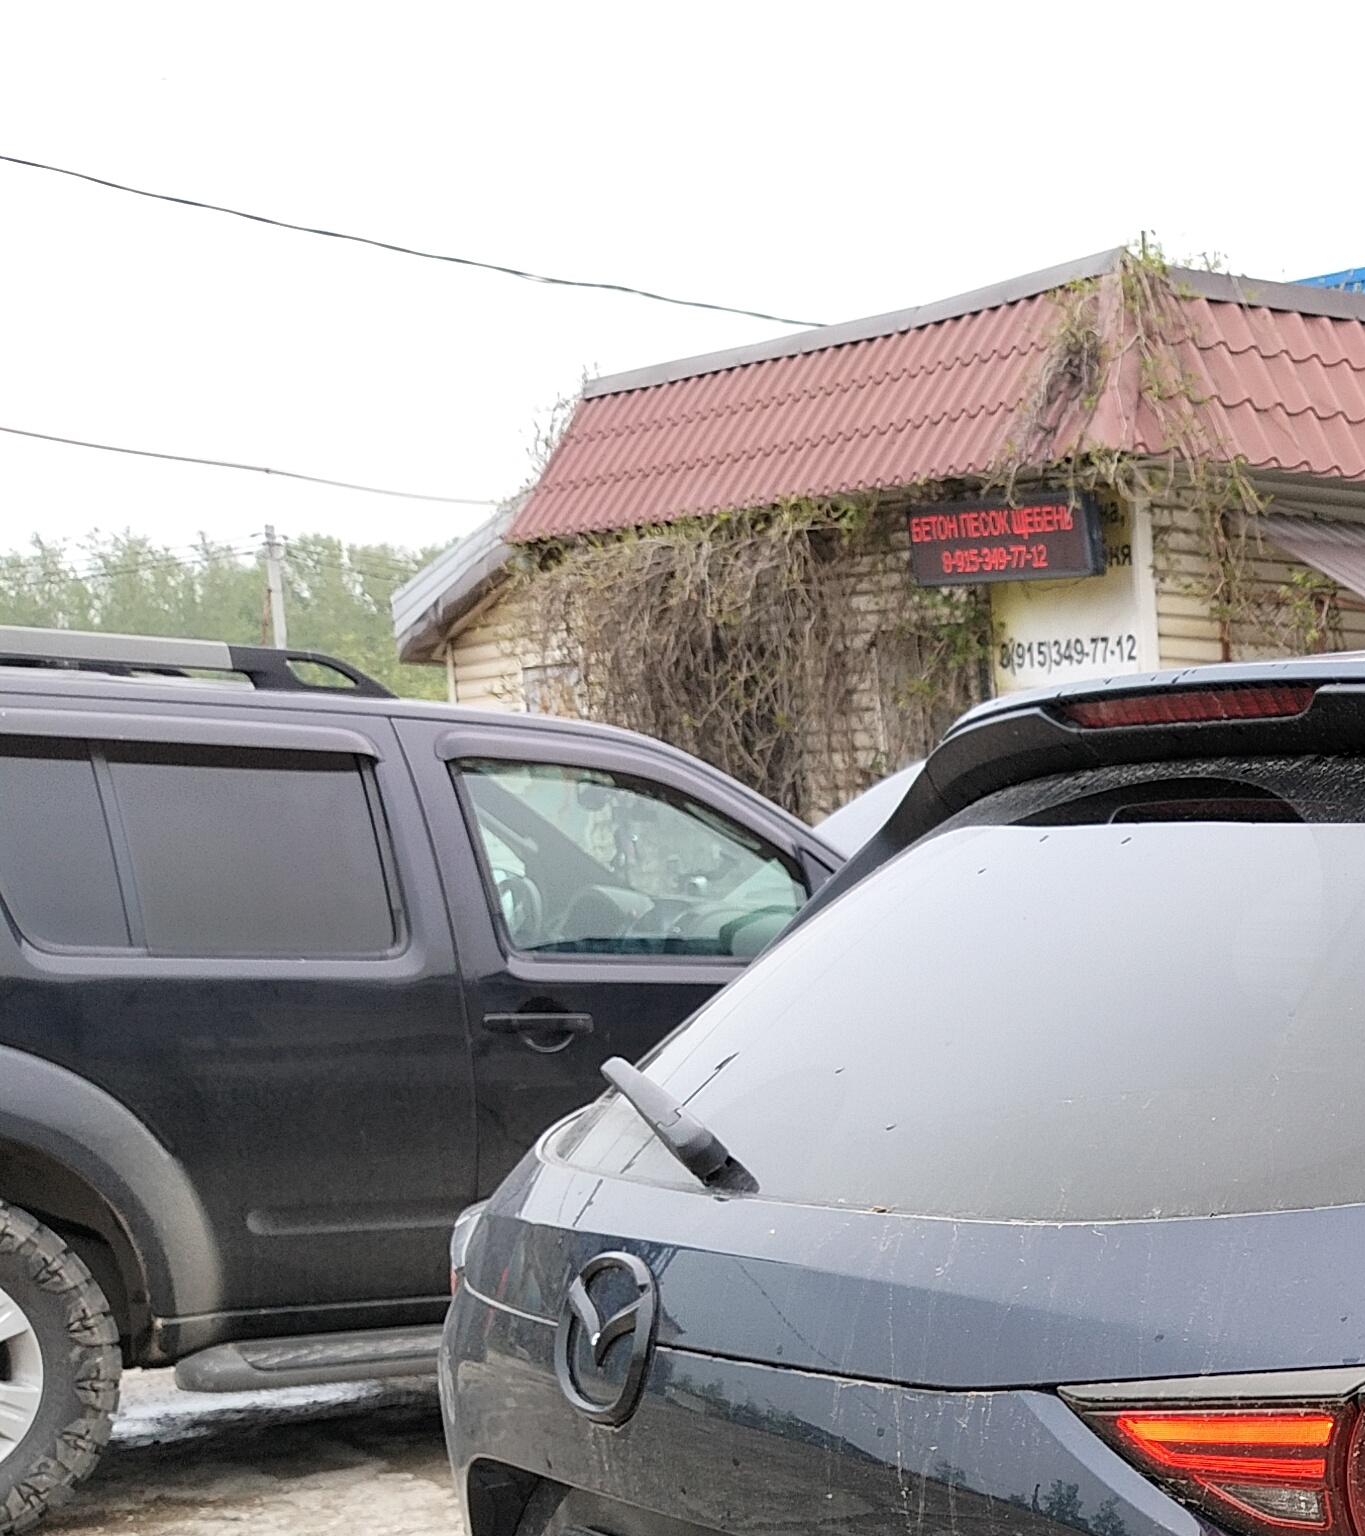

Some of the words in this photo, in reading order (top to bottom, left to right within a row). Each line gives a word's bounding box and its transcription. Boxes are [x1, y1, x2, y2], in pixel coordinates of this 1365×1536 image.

[910, 512, 958, 542] БЕТОН
[958, 508, 1010, 538] ПЕСОК
[1011, 503, 1073, 539] ЩЕБЕНЬ
[940, 543, 1049, 574] 8-915-349-77-12
